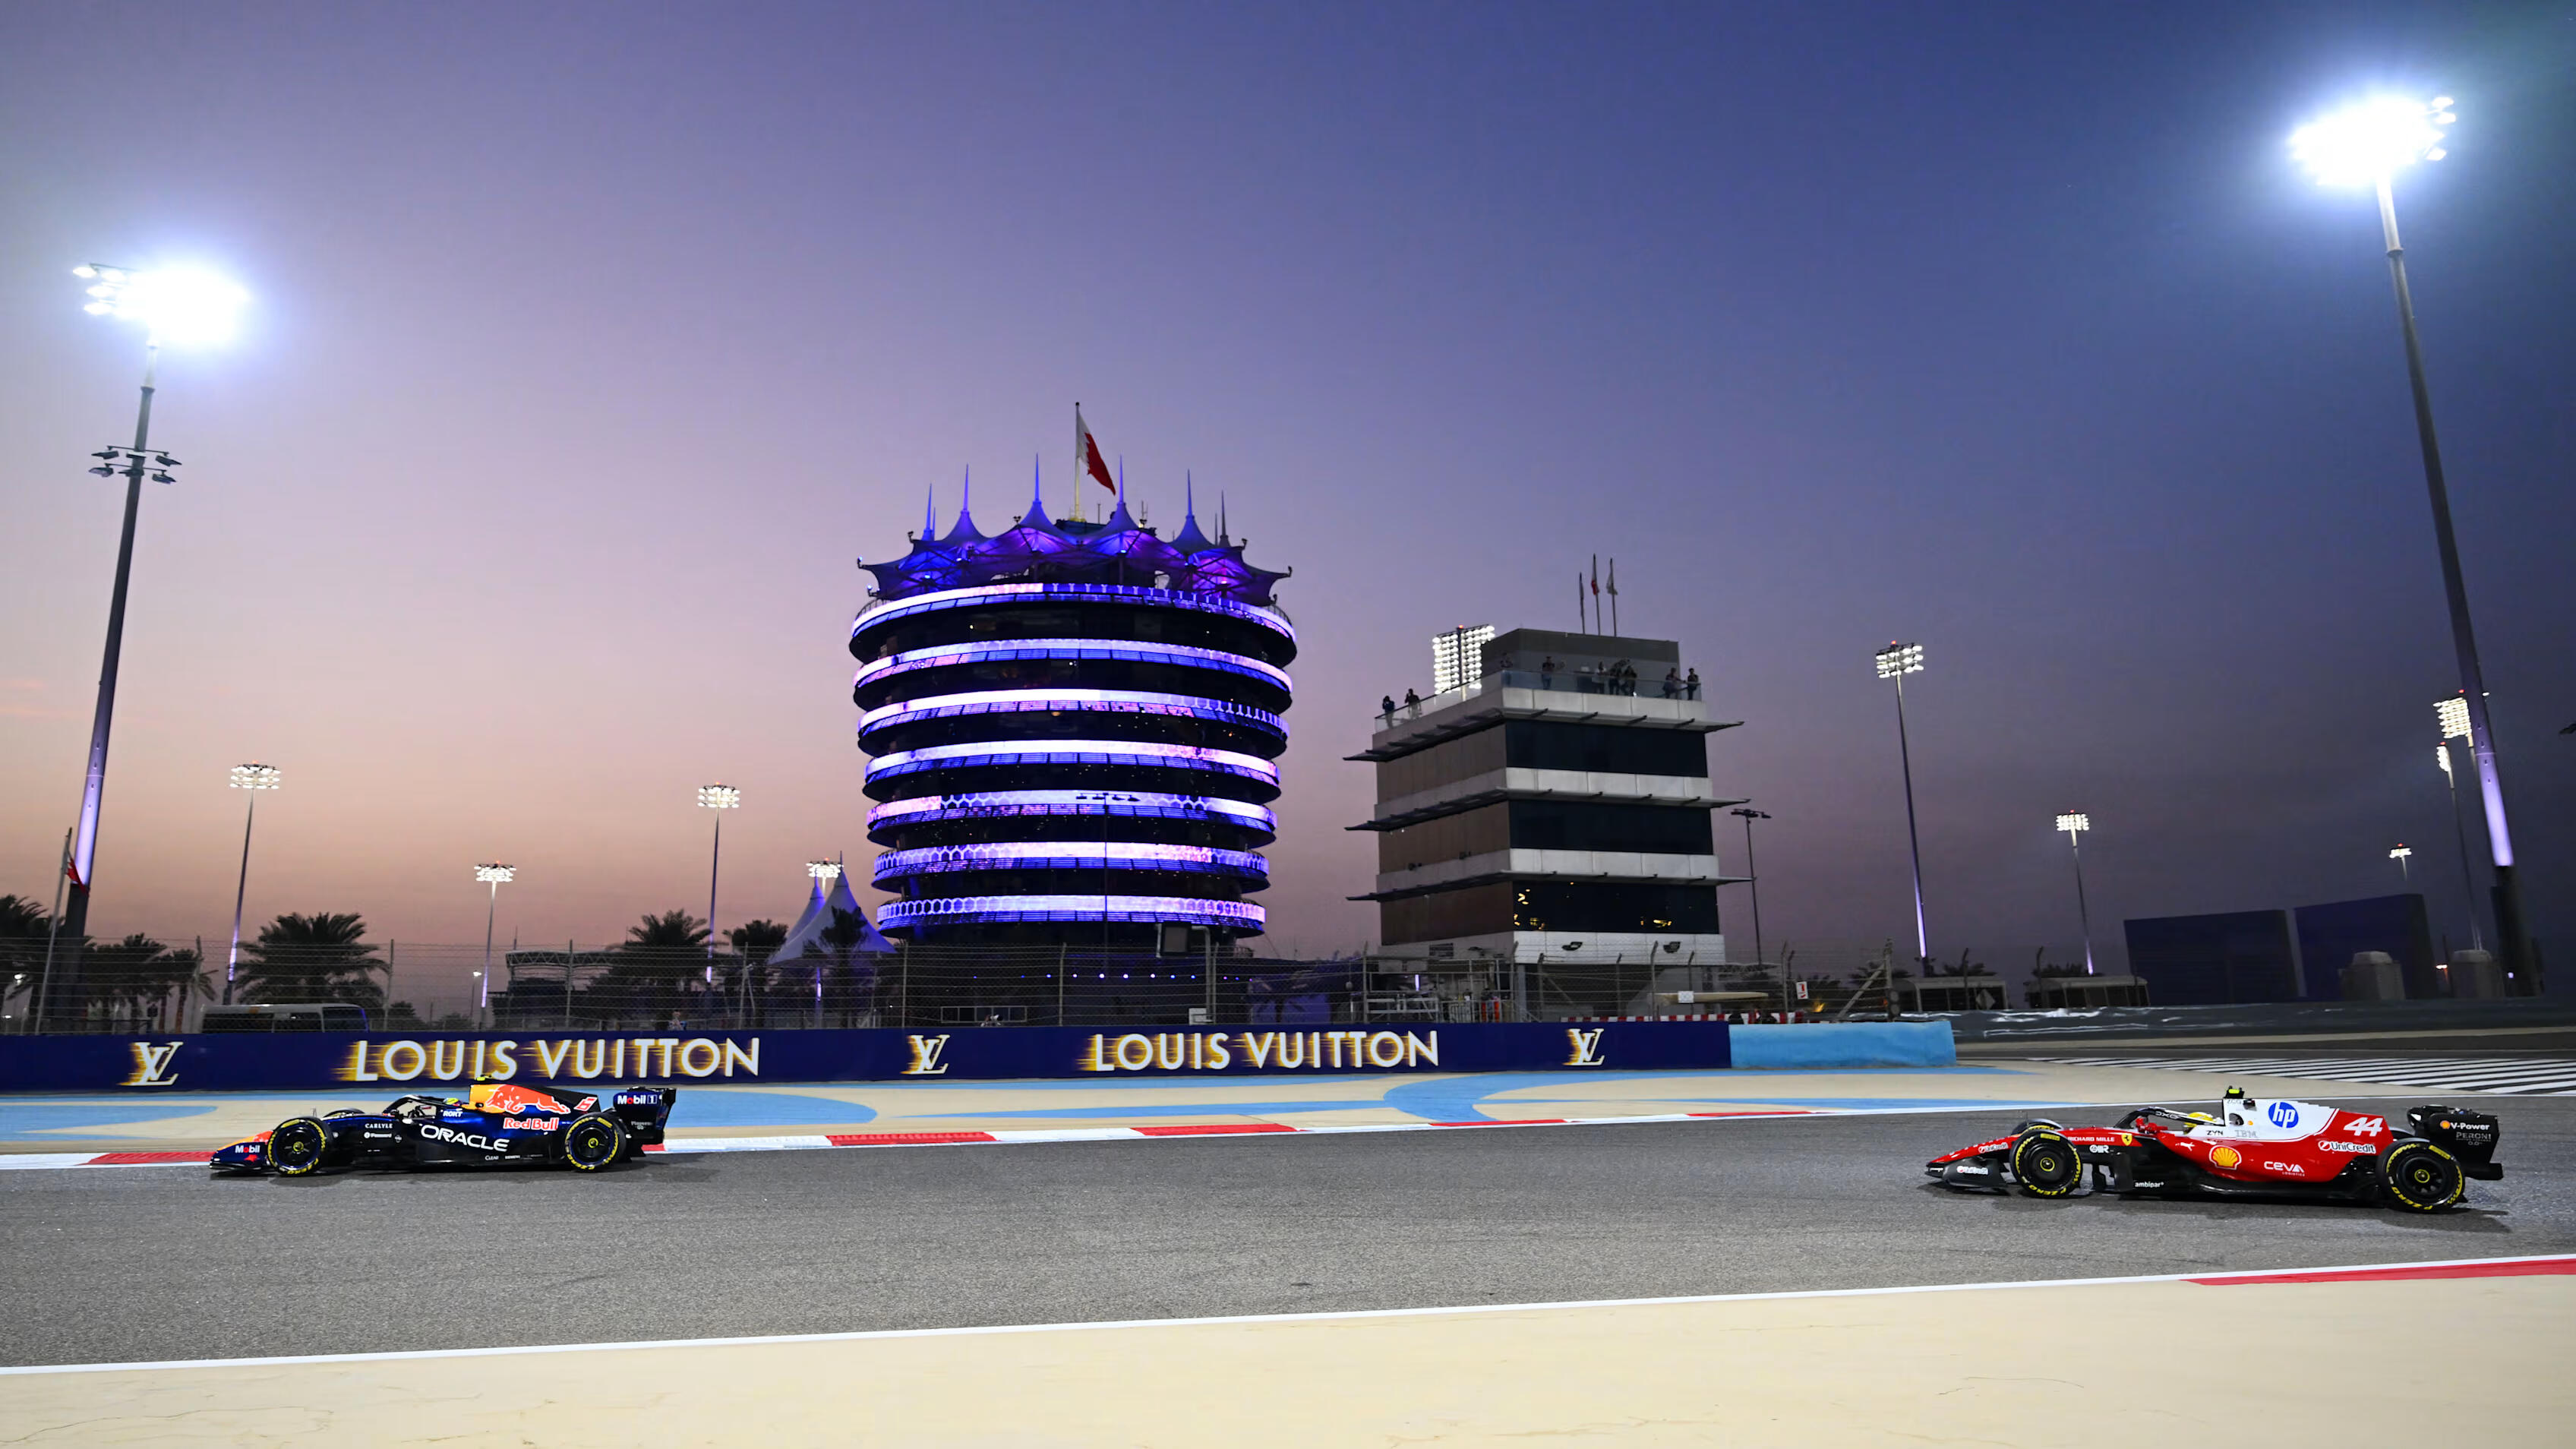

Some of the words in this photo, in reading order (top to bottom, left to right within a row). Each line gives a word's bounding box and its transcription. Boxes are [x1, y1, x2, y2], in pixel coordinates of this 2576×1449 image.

[1094, 1033, 1230, 1071] LOUIS
[1244, 1031, 1439, 1069] VUITTON
[354, 1040, 518, 1081] LOUIS
[536, 1037, 759, 1080] VUITTON
[573, 1096, 598, 1111] 6
[617, 1094, 646, 1104] Mobil
[649, 1094, 657, 1104] 1
[2272, 1102, 2296, 1129] hp
[503, 1117, 531, 1129] Red
[532, 1117, 560, 1131] Bull
[2343, 1116, 2384, 1137] 44
[2450, 1122, 2490, 1131] V-Power
[420, 1124, 510, 1152] ORACLE
[235, 1144, 260, 1154] Mobil
[2331, 1141, 2376, 1154] UniCredit
